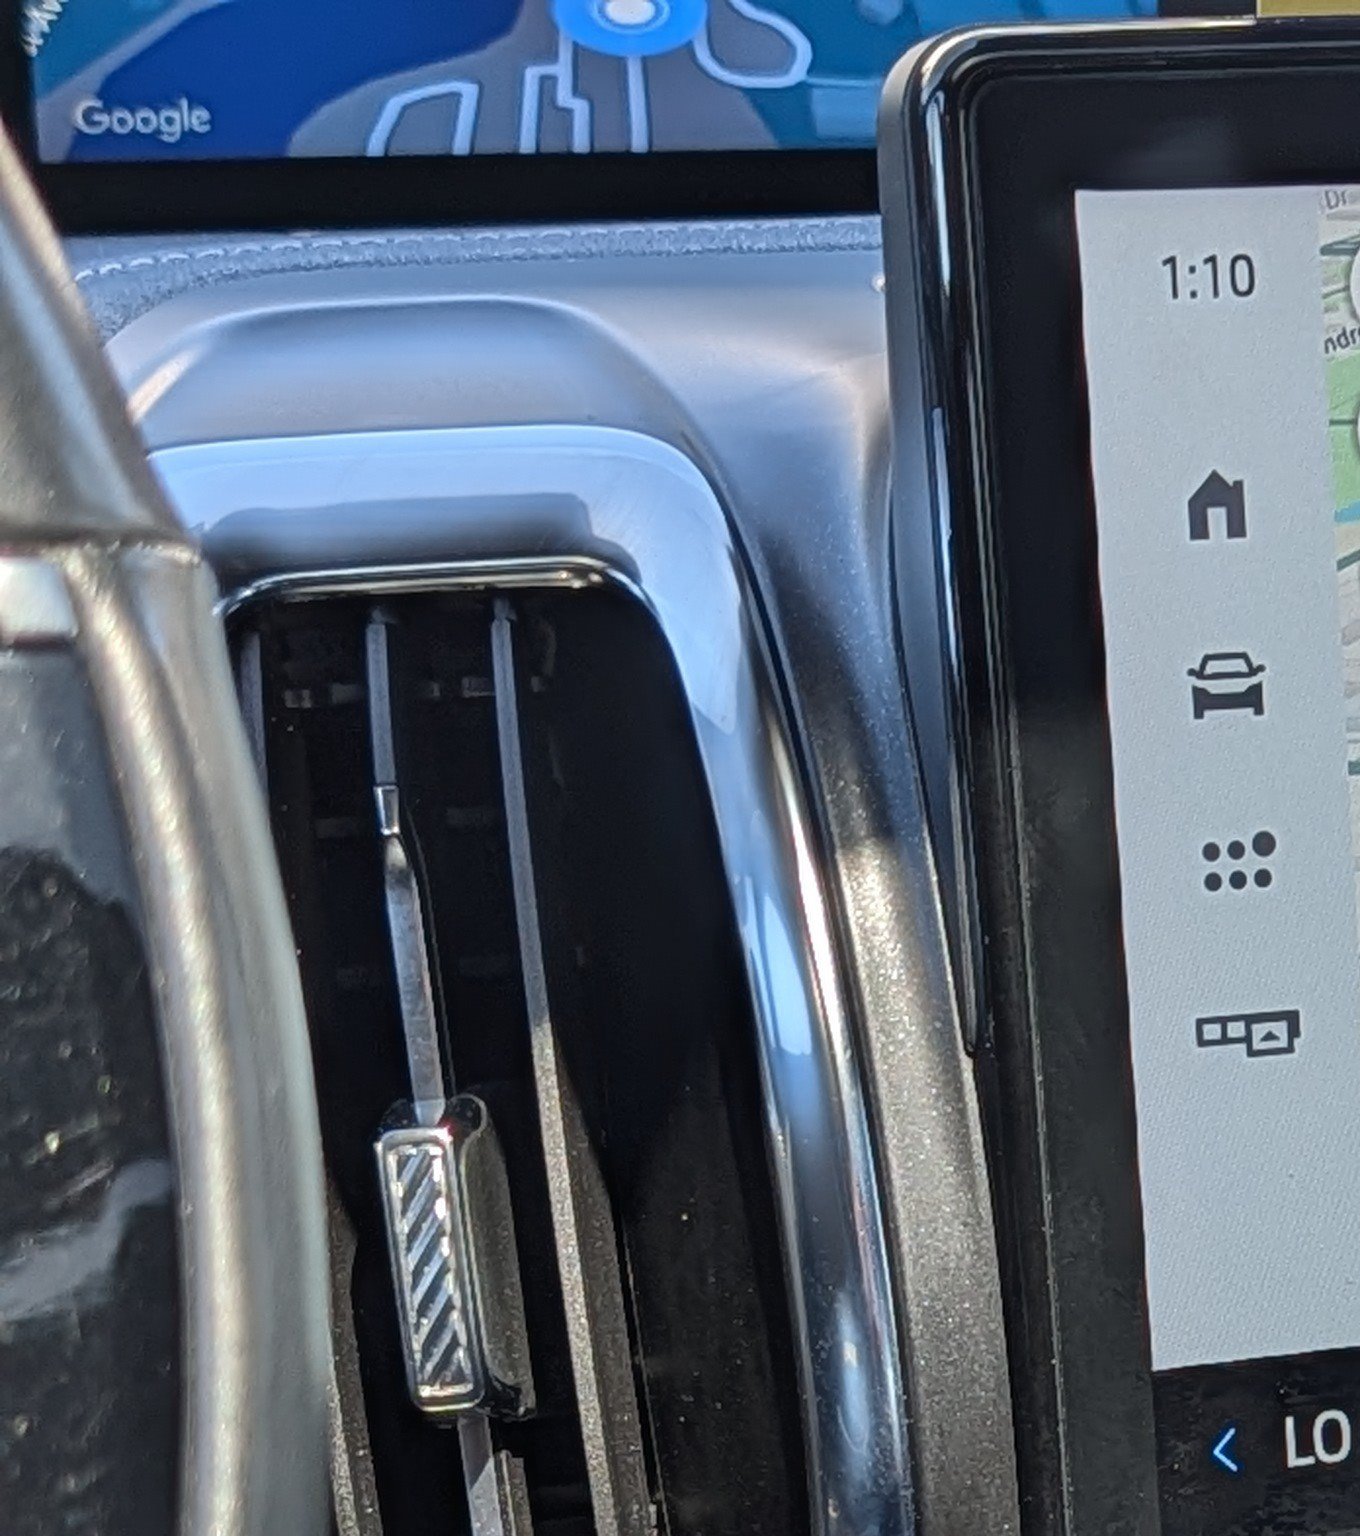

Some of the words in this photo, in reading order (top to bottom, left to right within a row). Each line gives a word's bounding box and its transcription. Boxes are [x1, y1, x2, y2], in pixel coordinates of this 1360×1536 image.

[73, 97, 213, 143] Google
[1161, 252, 1257, 301] 1:10
[1284, 1408, 1352, 1469] LO
